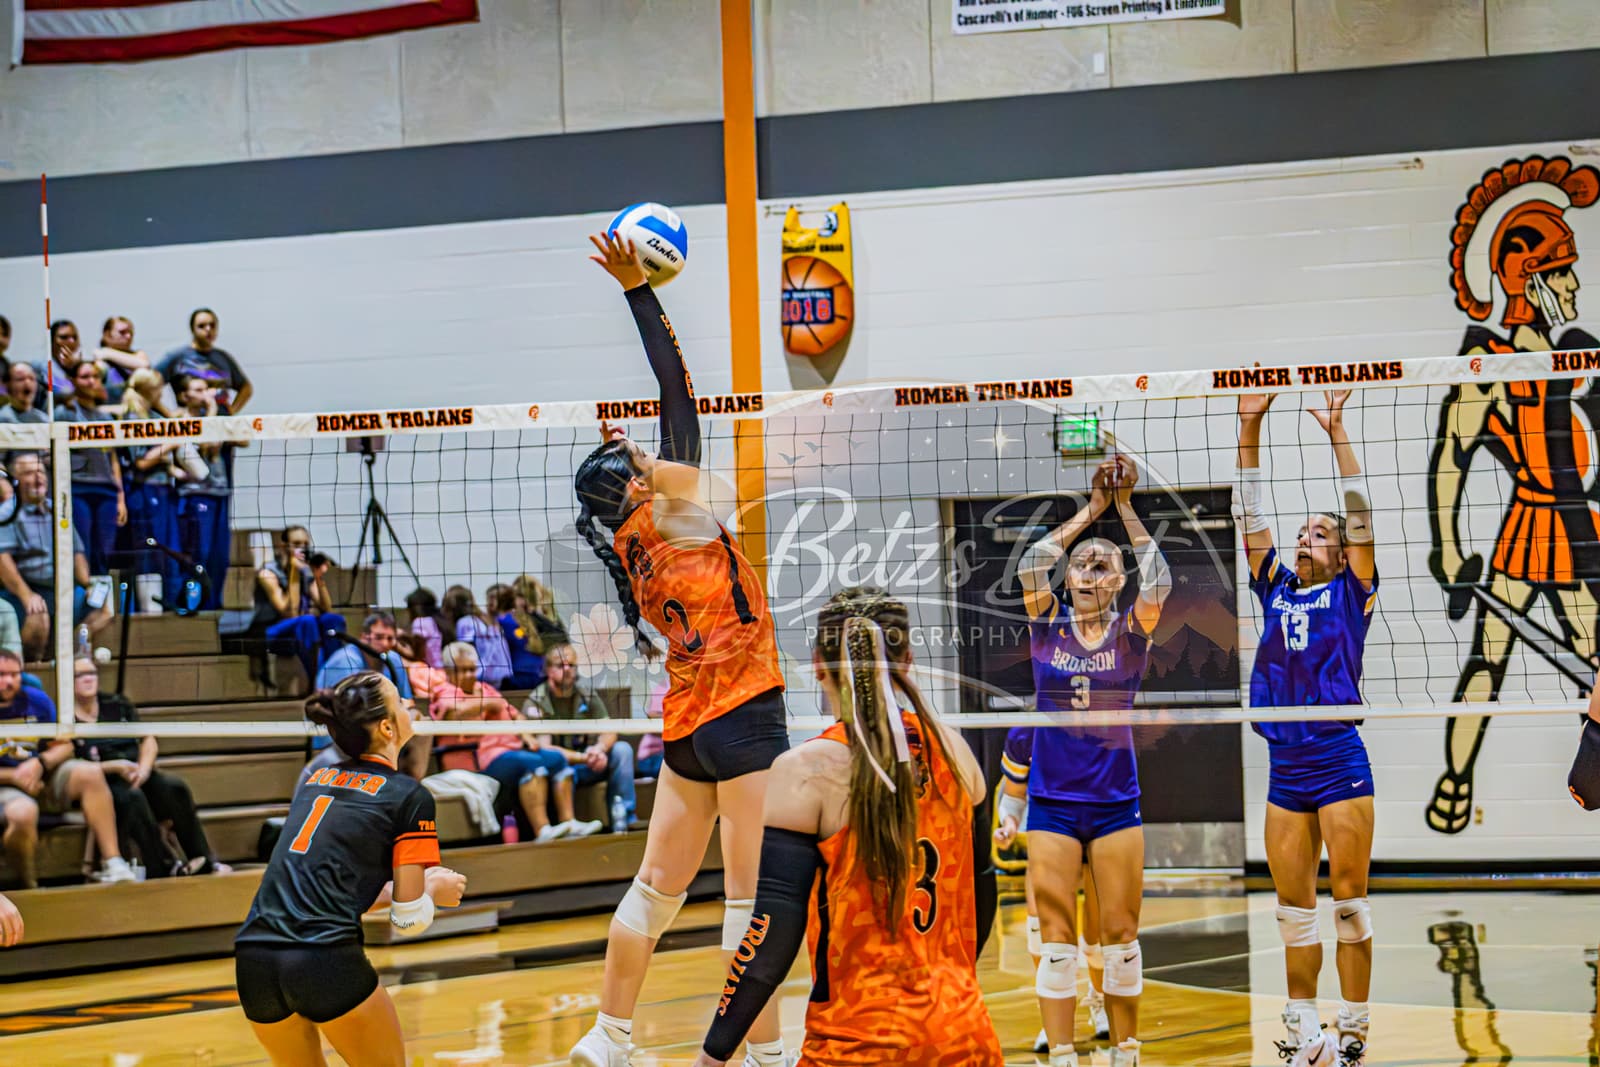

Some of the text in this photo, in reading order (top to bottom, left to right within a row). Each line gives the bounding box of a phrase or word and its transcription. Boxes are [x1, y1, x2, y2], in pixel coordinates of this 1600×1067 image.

[1014, 9, 1024, 22] of
[1026, 9, 1058, 20] Homer
[1086, 4, 1120, 17] Screen
[1121, 1, 1162, 15] Printing
[1213, 361, 1404, 389] HOMER TROJANS
[696, 395, 764, 415] OJANS
[895, 379, 1073, 406] HOMER TROJANS
[120, 419, 203, 438] TROJANS
[316, 408, 474, 432] HOMER TROJANS
[662, 598, 704, 653] 2
[1281, 611, 1310, 651] 13
[1050, 646, 1116, 673] BRONSON
[1070, 675, 1090, 709] 3
[289, 794, 334, 855] 1
[912, 836, 941, 936] 3
